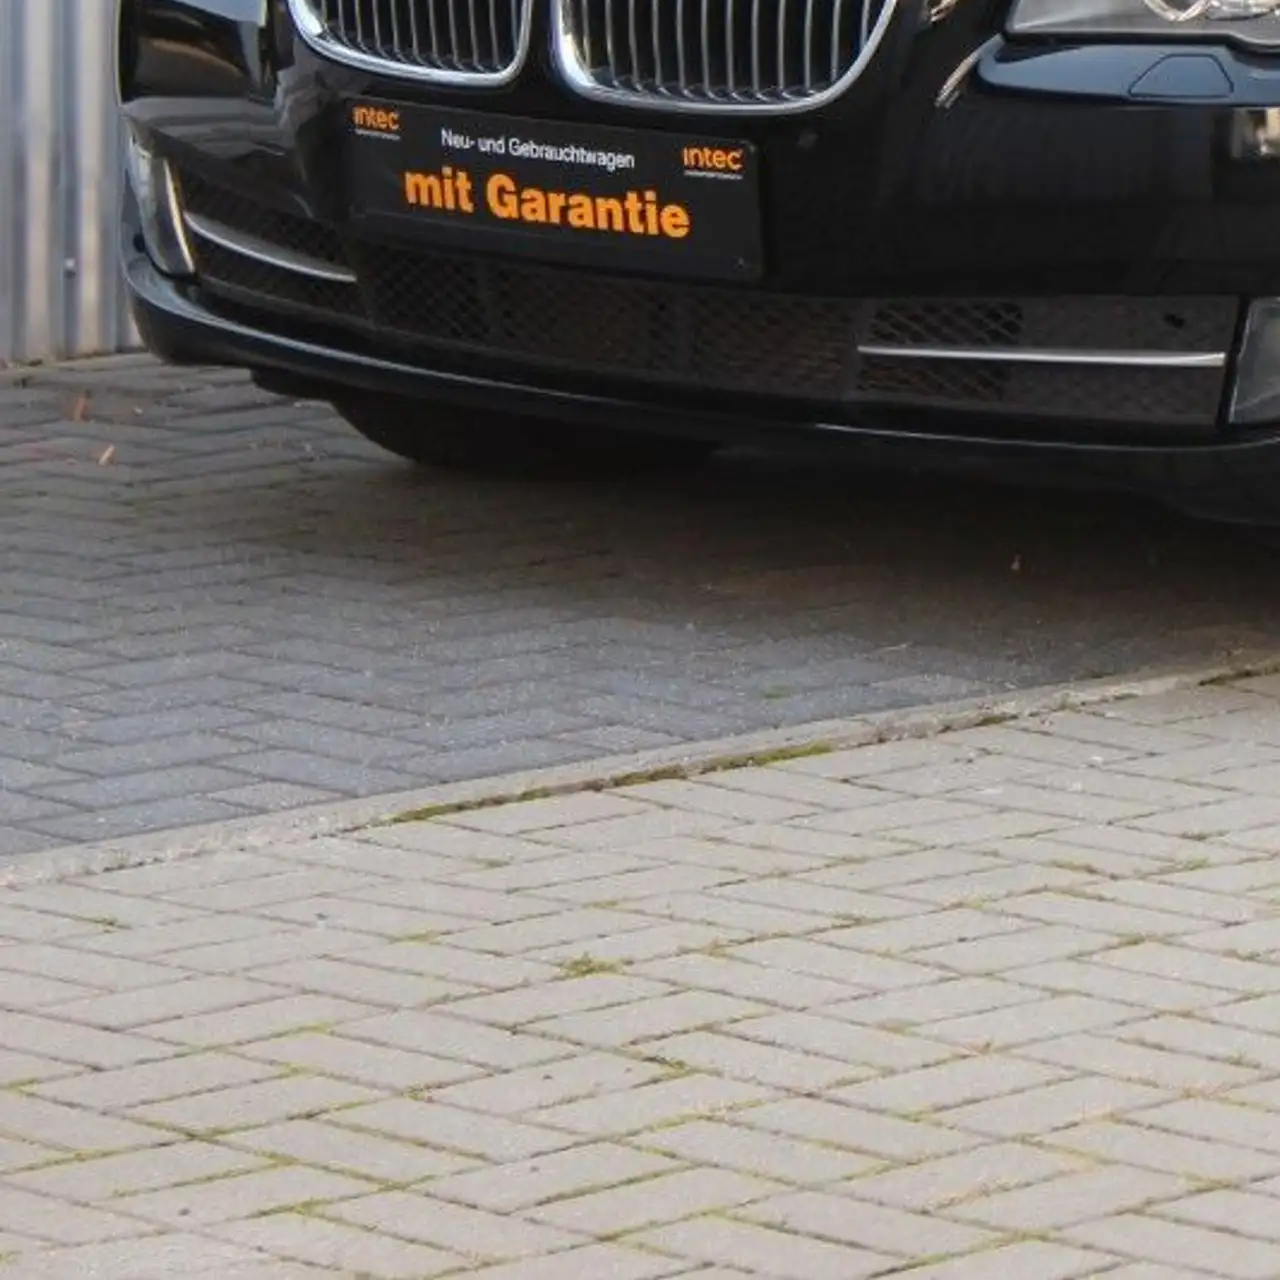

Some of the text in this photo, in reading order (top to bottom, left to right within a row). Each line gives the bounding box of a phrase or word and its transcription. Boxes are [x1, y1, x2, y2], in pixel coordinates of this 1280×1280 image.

[440, 127, 635, 172] Neu- und Gebrauchtwagen
[683, 146, 743, 170] intec
[405, 166, 691, 238] mit Garantie
